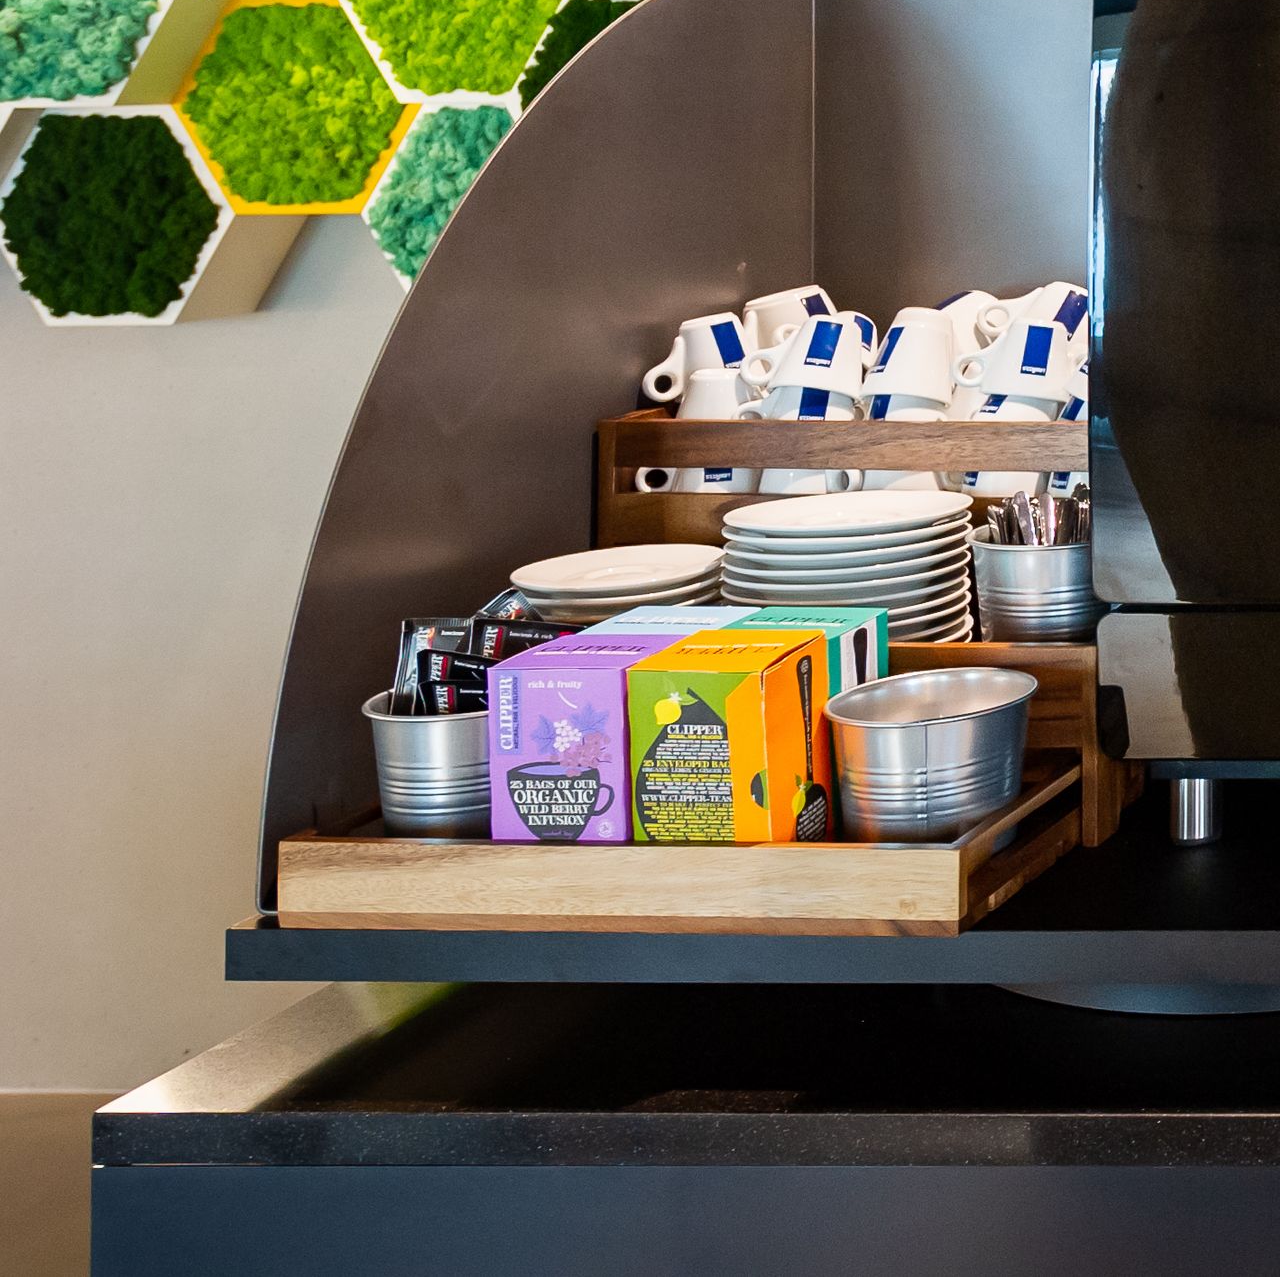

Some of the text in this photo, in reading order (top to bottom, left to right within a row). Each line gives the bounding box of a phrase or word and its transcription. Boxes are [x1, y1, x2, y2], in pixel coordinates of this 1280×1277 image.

[528, 679, 583, 690] rich & fruity
[499, 674, 514, 750] CLIPPER
[667, 724, 723, 735] CLIPPER
[656, 759, 710, 768] ENVELOPED
[510, 779, 598, 789] 25 BAGS OF OUR
[513, 789, 596, 804] ORGANIC
[519, 804, 591, 814] WILD BERRY
[528, 814, 586, 826] INFUSION
